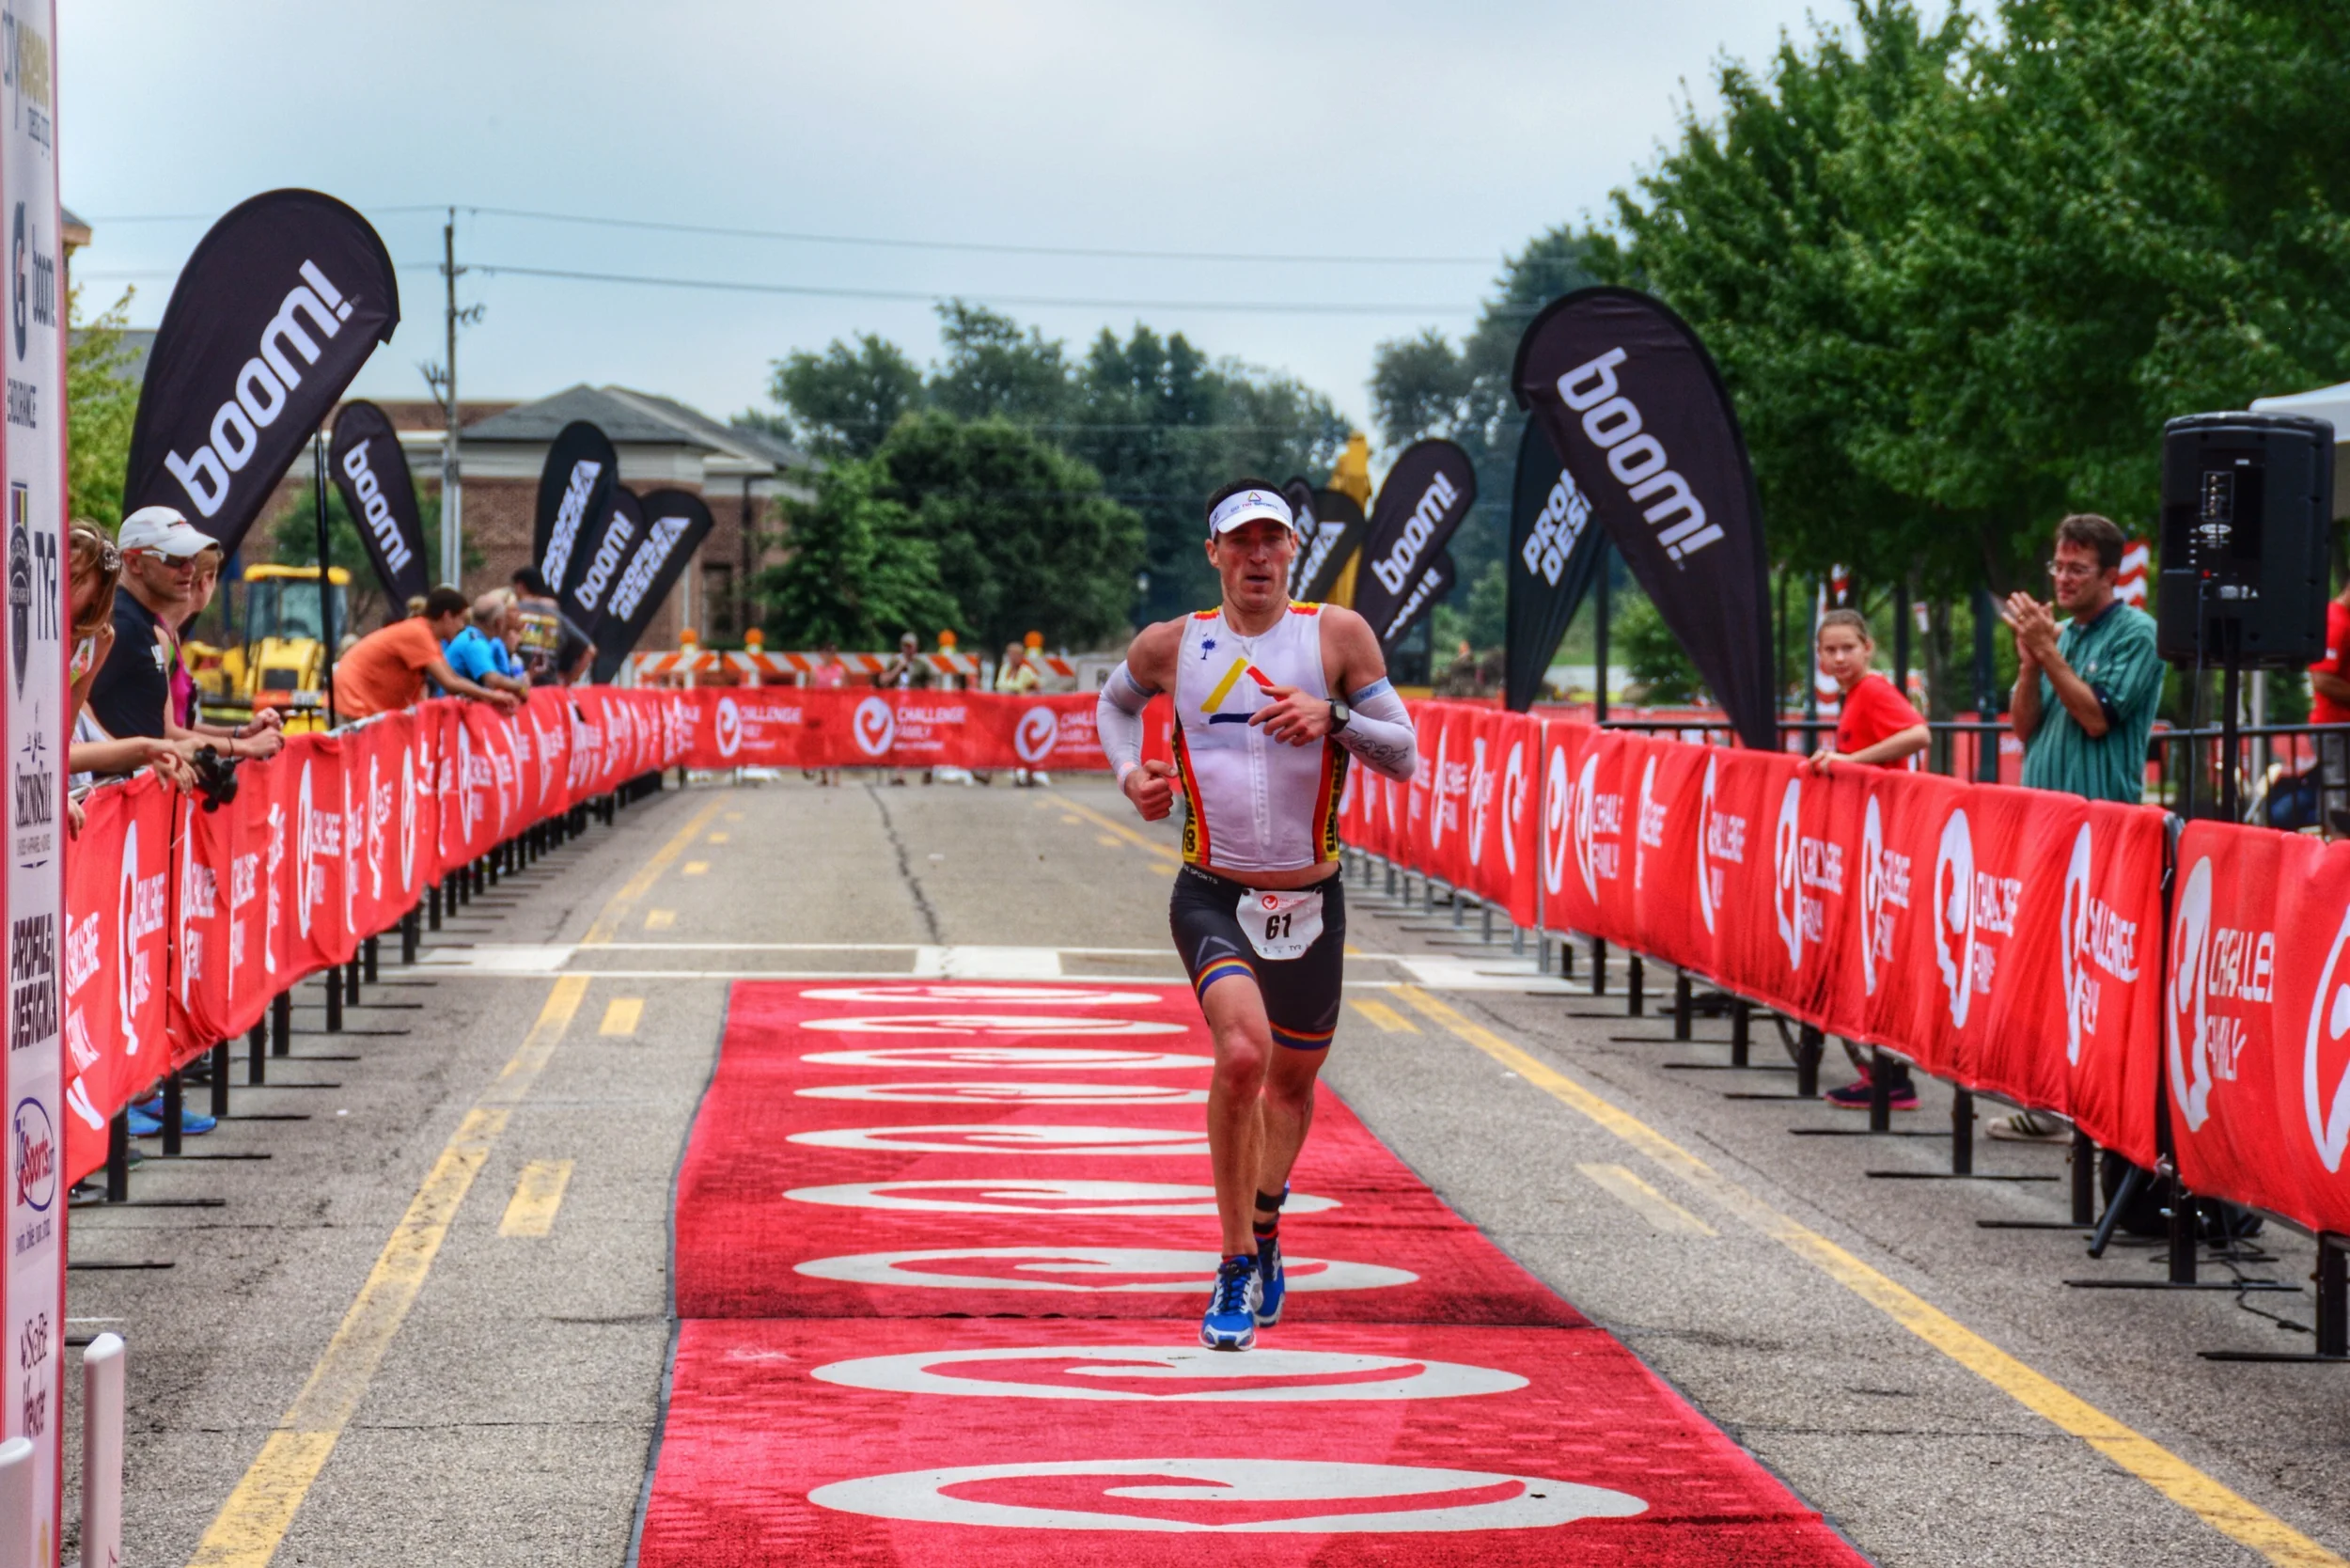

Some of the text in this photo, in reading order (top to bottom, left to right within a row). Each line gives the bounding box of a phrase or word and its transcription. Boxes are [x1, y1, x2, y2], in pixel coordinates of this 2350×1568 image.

[164, 259, 353, 518] boom!
[1556, 347, 1725, 562] boom!
[342, 438, 413, 574] boom!
[1371, 470, 1458, 596] boom!
[34, 530, 56, 639] TYR
[573, 510, 635, 611] boom!
[897, 706, 967, 724] CHALLENGE
[1185, 829, 1196, 853] GO
[1190, 868, 1218, 885] SPORTS
[10, 913, 53, 983] PROFILE
[1265, 913, 1292, 941] 61
[1289, 944, 1302, 952] TYR
[11, 979, 51, 1052] DESIGN
